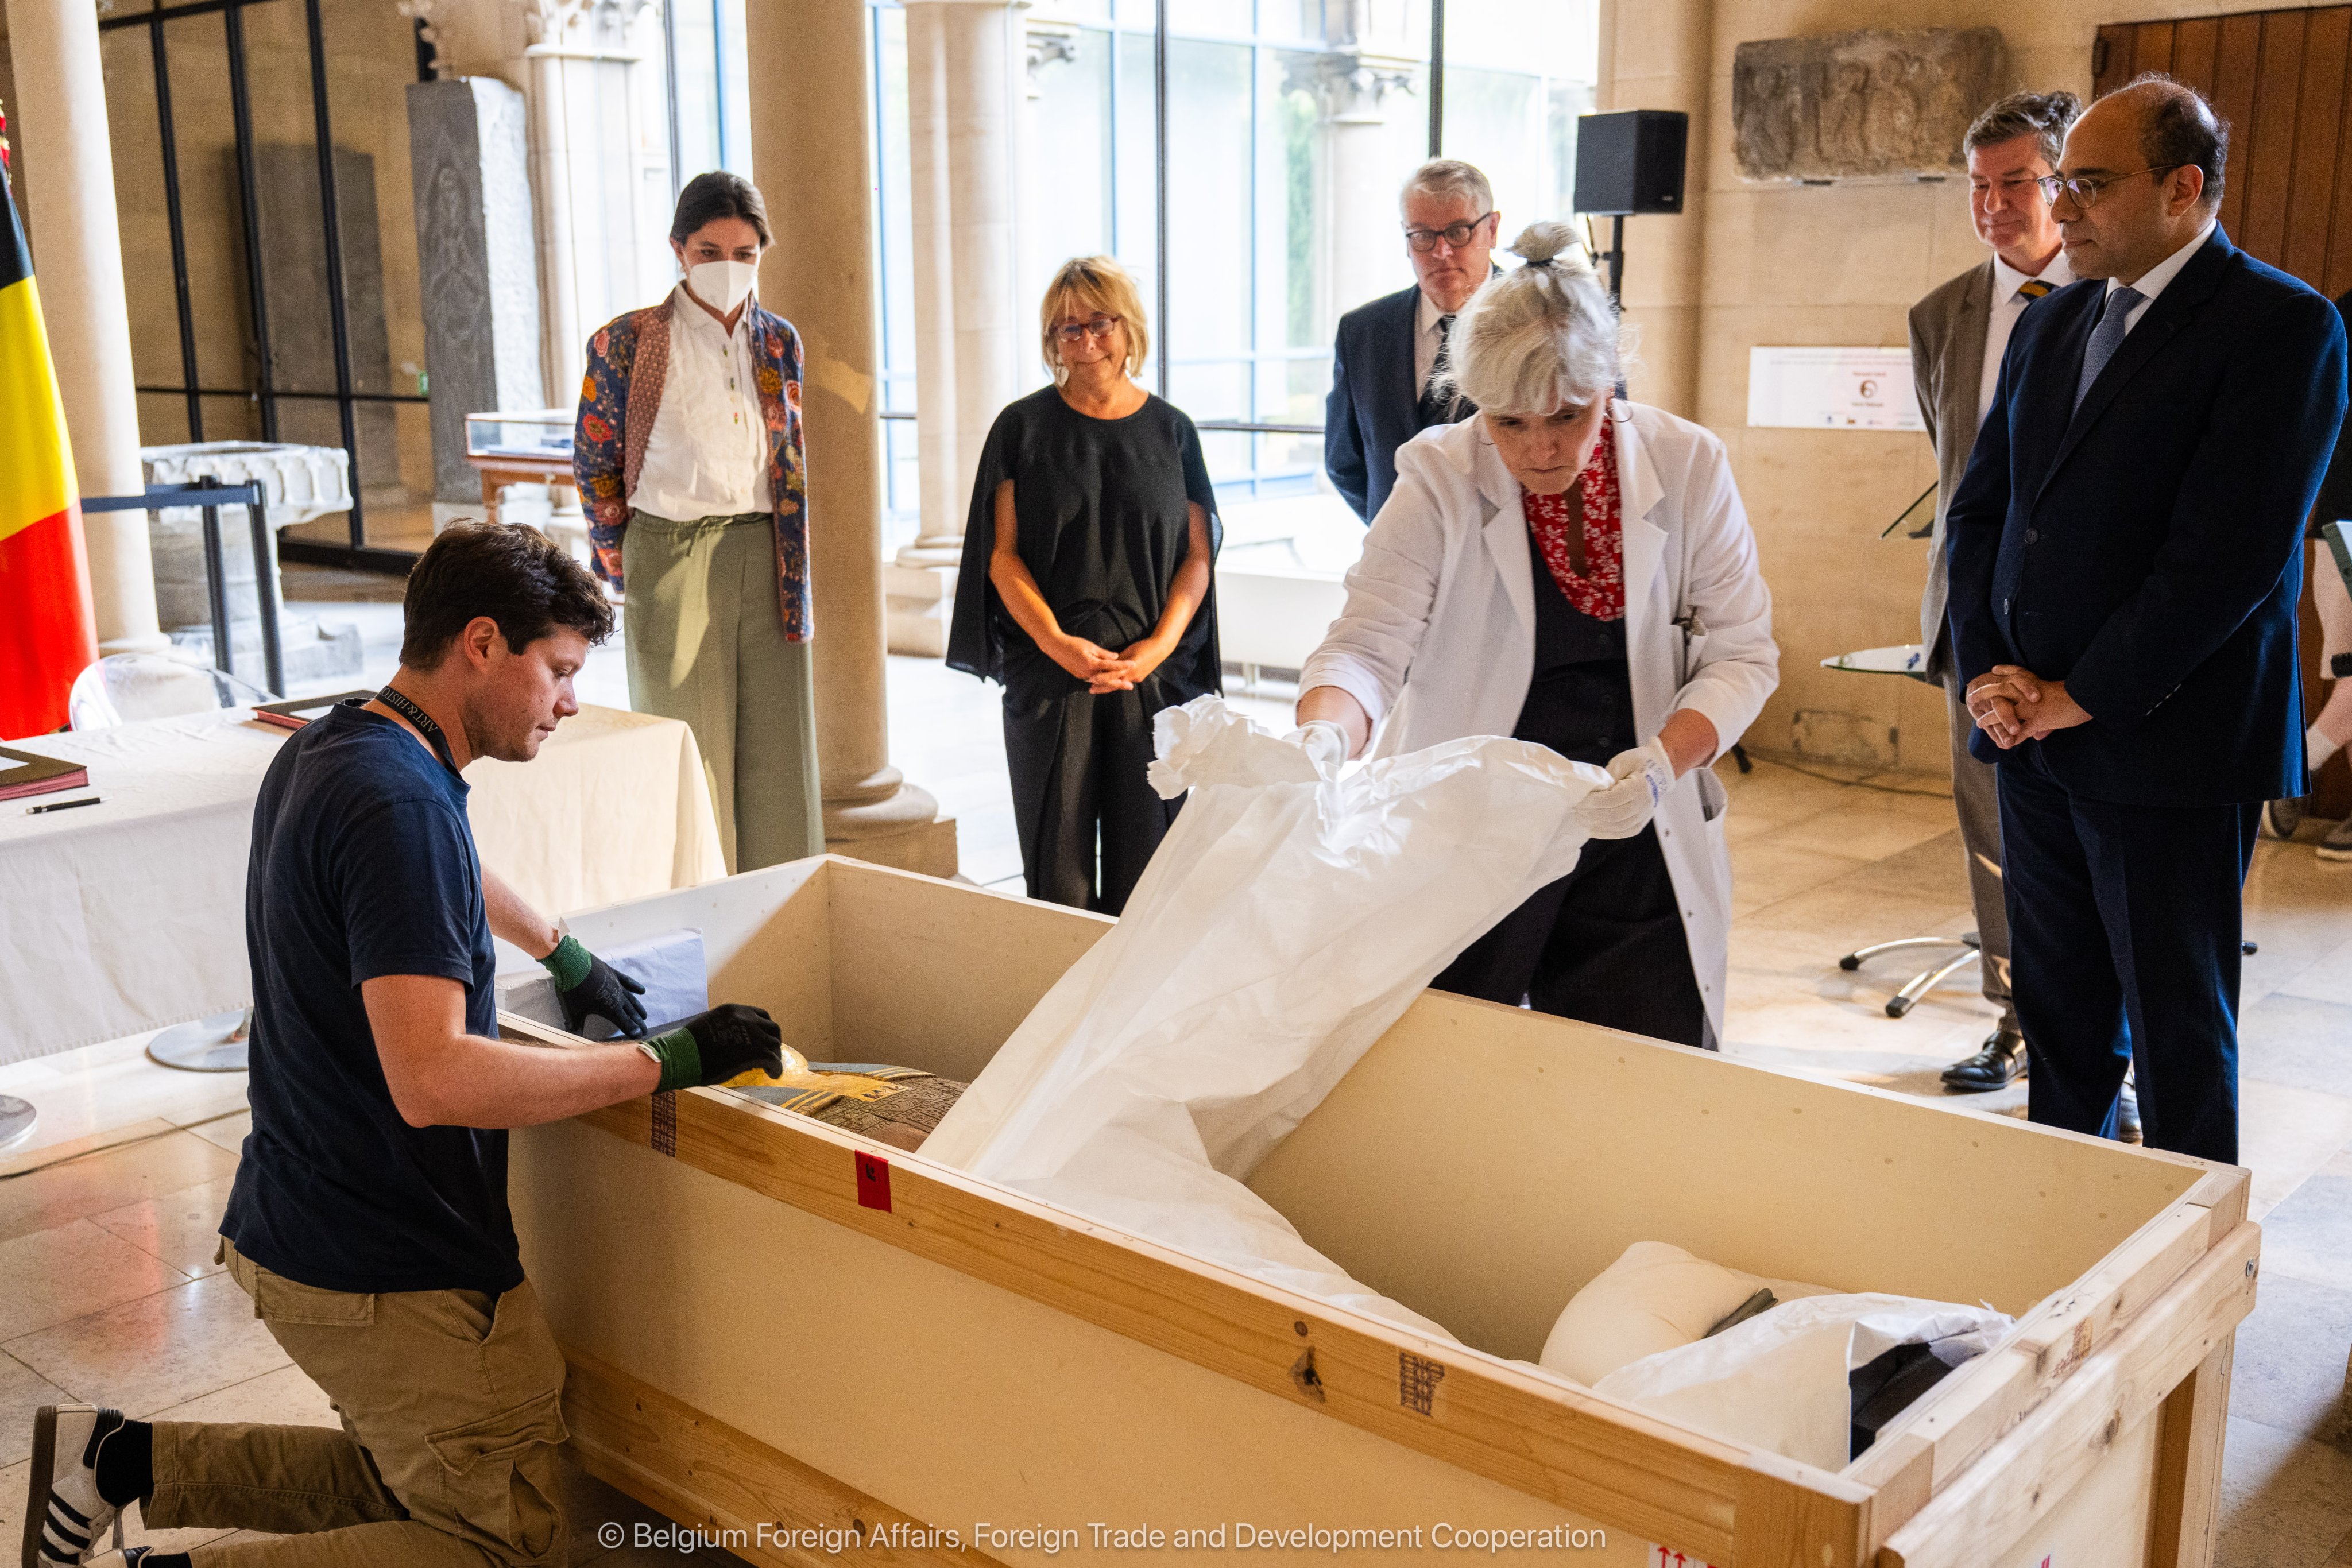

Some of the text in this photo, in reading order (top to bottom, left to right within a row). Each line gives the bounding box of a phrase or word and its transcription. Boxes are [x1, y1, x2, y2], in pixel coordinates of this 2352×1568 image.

[379, 688, 438, 732] ART & HISTO
